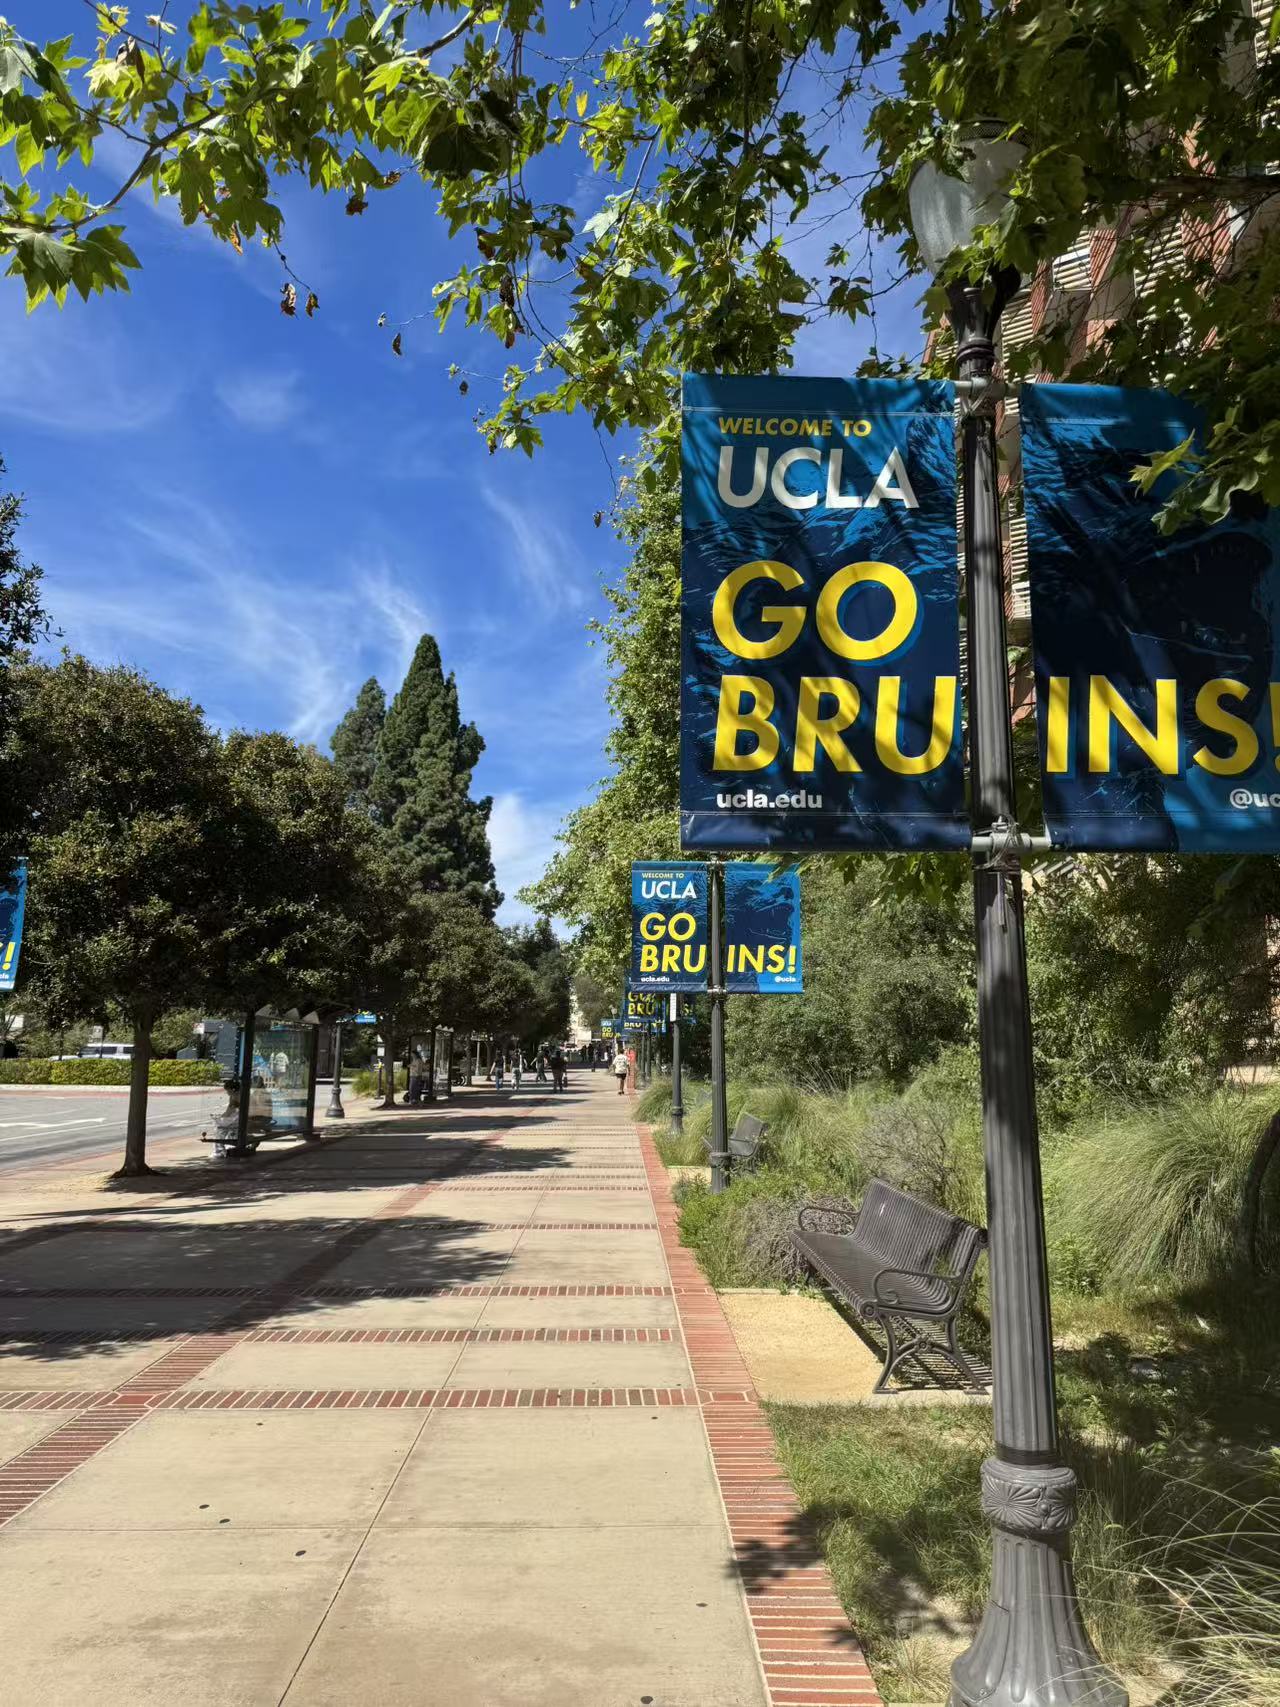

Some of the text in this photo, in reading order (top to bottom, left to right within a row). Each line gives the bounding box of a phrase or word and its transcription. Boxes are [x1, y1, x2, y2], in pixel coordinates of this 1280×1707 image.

[719, 417, 872, 437] WELCOME TO
[717, 445, 920, 510] UCLA
[712, 561, 918, 662] GO
[712, 674, 957, 776] BRU
[716, 789, 822, 808] ucla.edu
[641, 880, 697, 899] UCLA
[640, 912, 697, 942] GO
[640, 944, 707, 973] BRU
[727, 944, 797, 974] INS!
